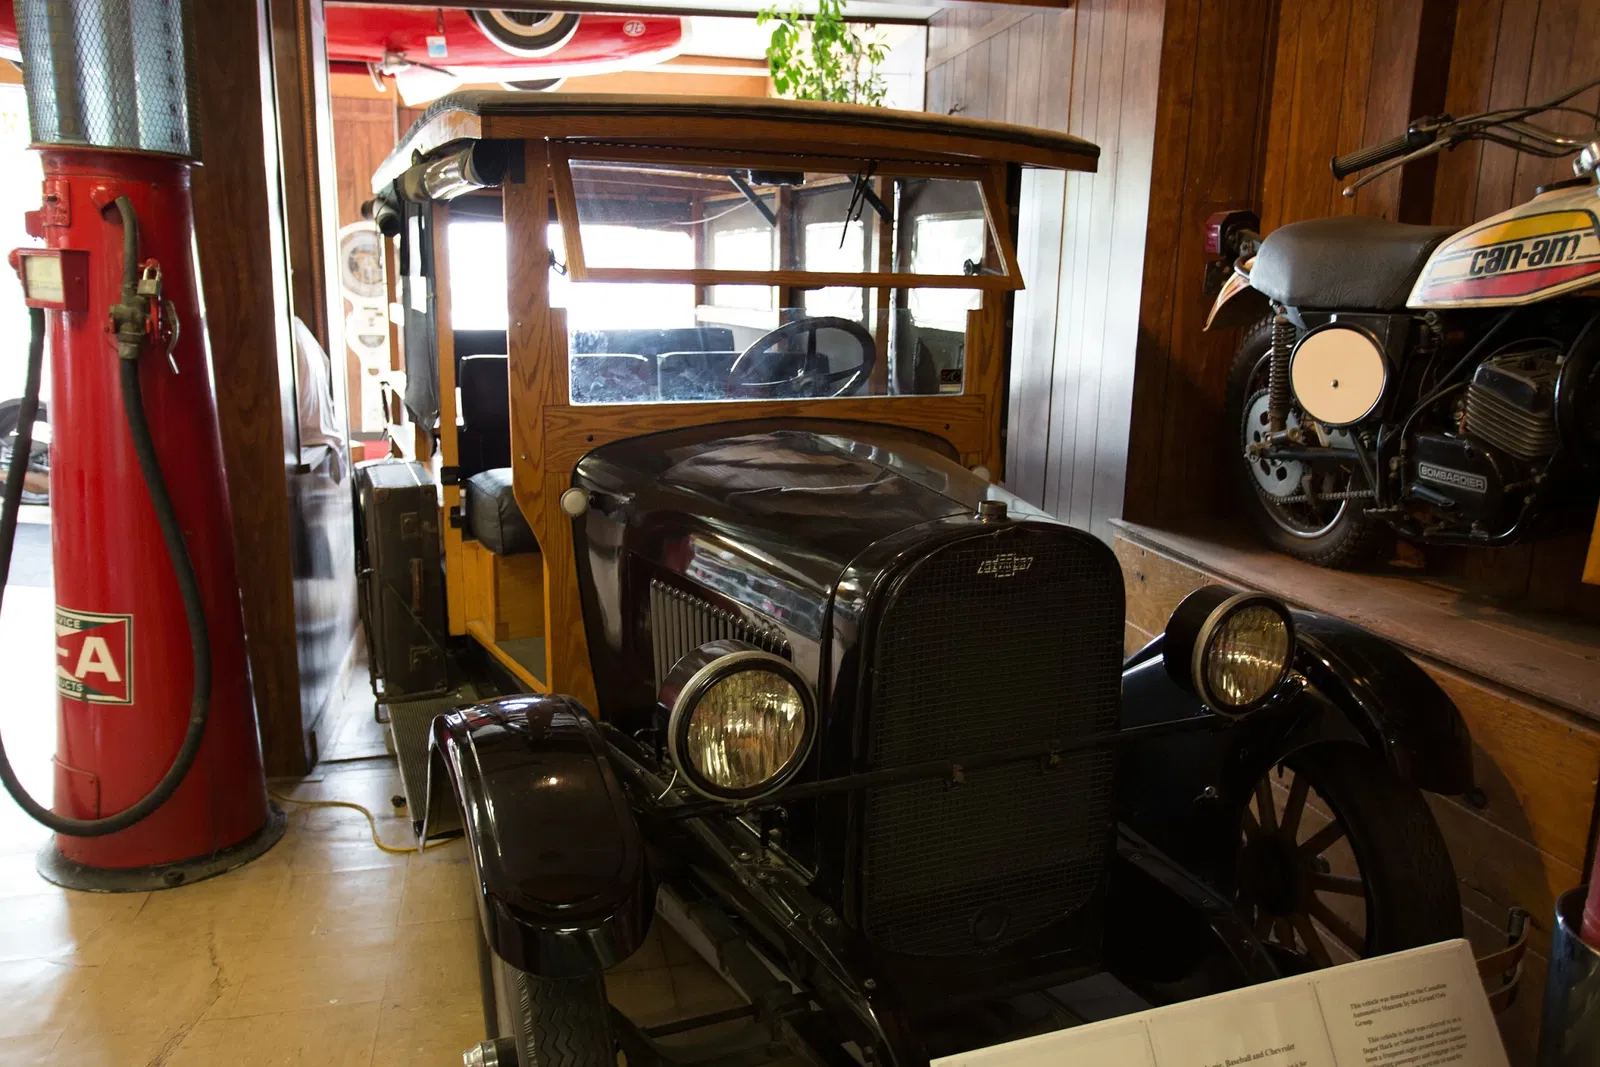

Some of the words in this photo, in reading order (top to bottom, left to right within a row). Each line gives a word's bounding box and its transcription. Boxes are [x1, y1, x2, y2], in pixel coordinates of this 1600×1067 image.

[1470, 234, 1581, 276] can-am
[1421, 466, 1484, 489] BOMBARDIER
[57, 615, 81, 629] VICE
[1225, 1054, 1251, 1067] Baseball
[1252, 1051, 1264, 1060] and
[1264, 1043, 1295, 1056] Chevrolet
